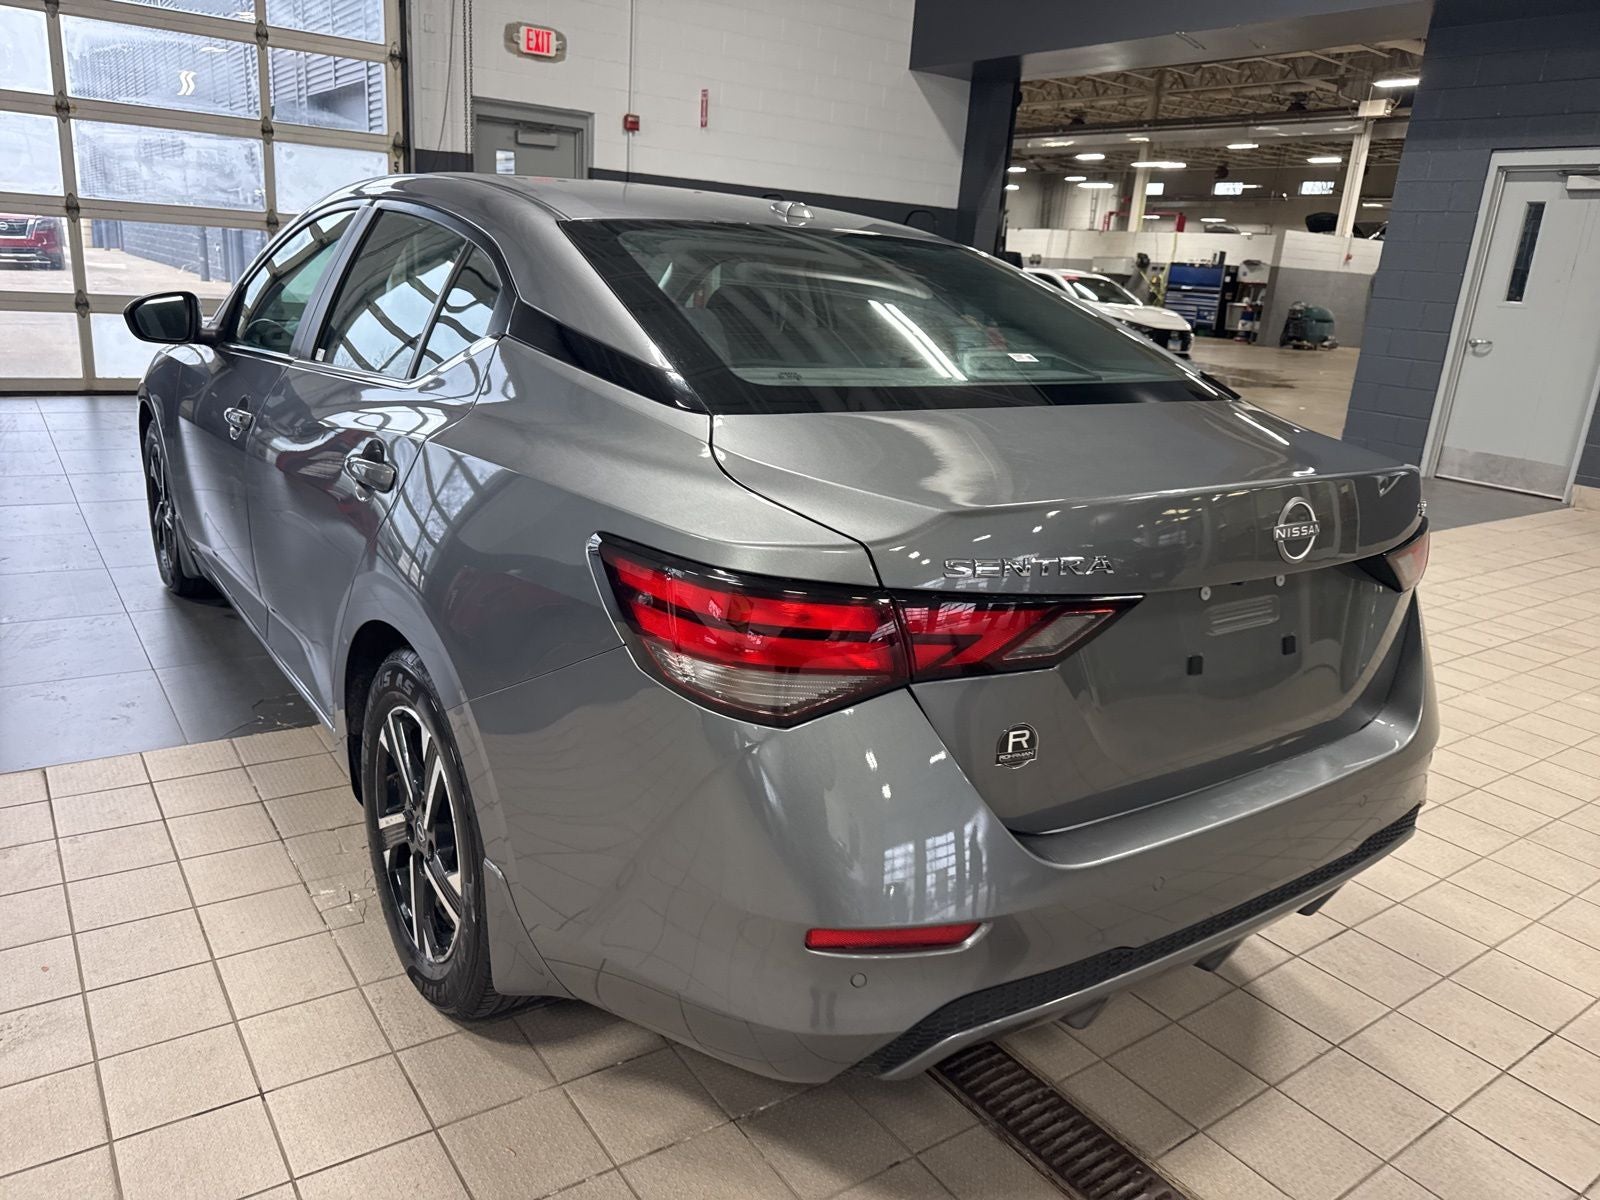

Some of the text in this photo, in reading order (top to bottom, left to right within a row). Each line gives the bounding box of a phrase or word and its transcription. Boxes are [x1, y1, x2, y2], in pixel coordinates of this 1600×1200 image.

[526, 28, 552, 53] EXIT
[1275, 524, 1320, 539] NISSAN
[943, 556, 1114, 578] SENTRA
[1007, 730, 1031, 753] R
